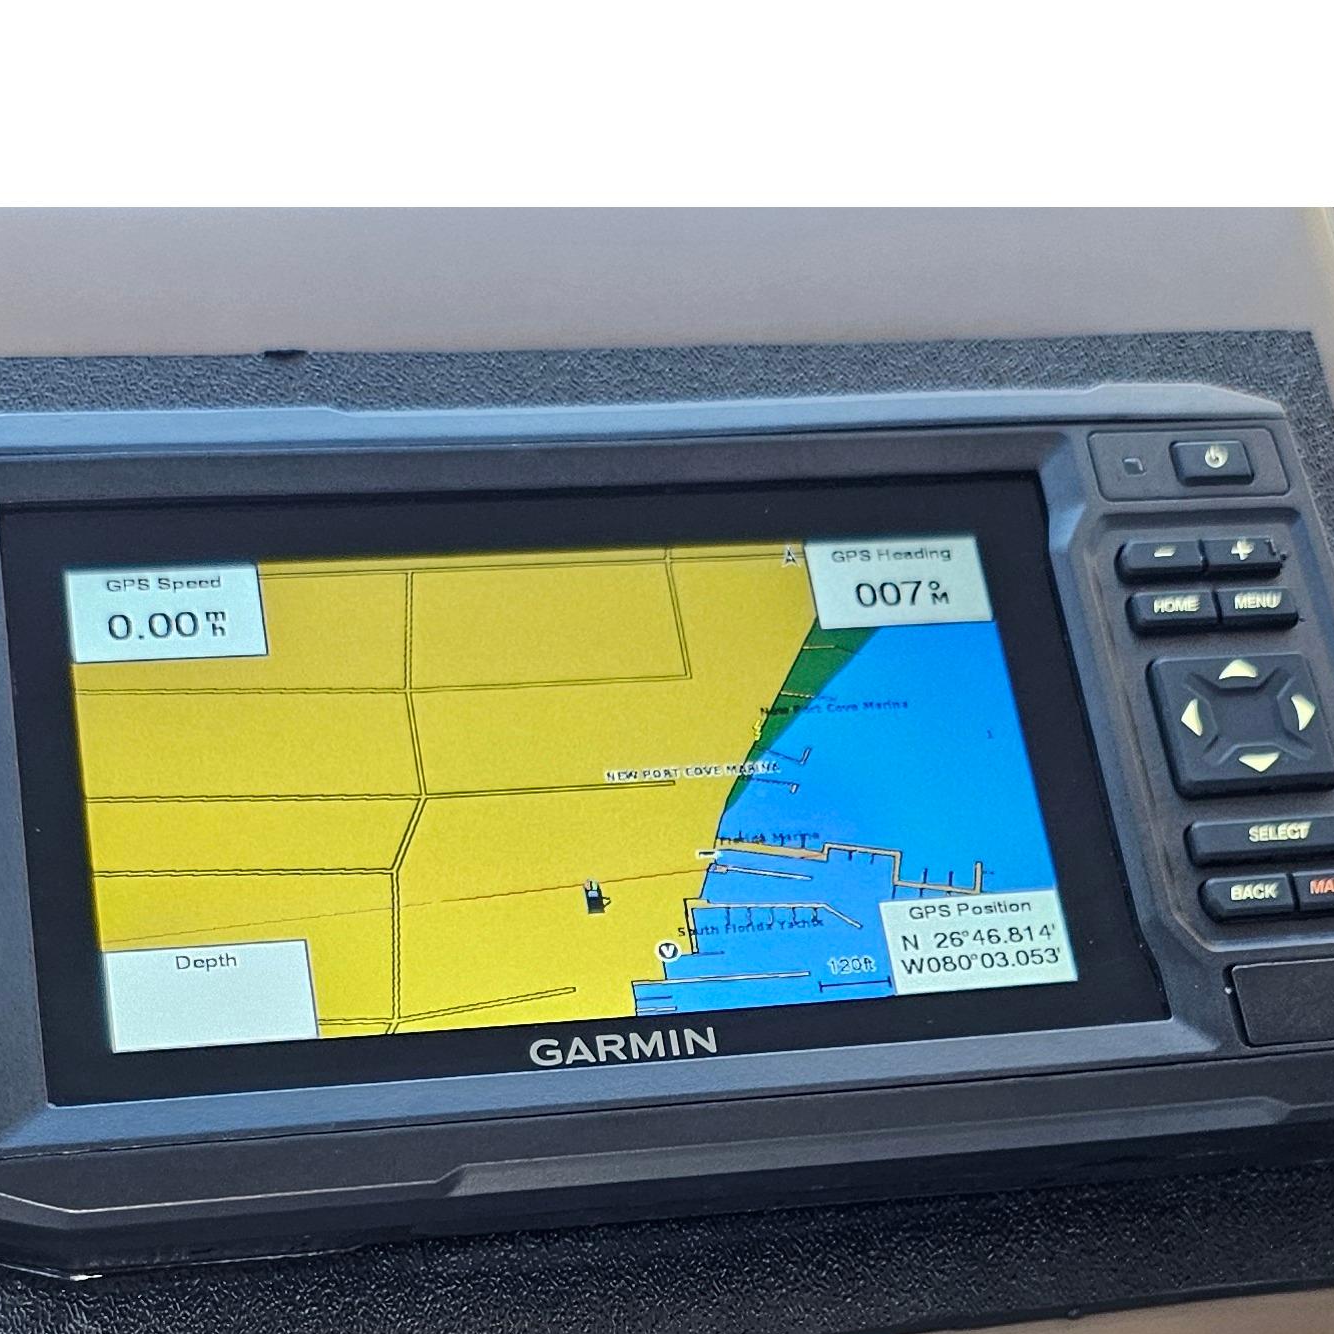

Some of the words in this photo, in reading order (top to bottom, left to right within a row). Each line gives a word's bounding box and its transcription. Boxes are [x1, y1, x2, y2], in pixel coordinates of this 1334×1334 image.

[831, 550, 871, 563] GPS
[877, 547, 951, 561] Heading
[106, 578, 150, 592] GPS
[157, 576, 221, 593] Speed
[1153, 595, 1200, 613] HOME
[1234, 591, 1282, 610] MENU
[107, 611, 199, 640] 0.00
[1248, 821, 1312, 842] SELECT
[1230, 881, 1278, 901] BACK
[909, 904, 951, 920] GPS
[957, 900, 1032, 917] Position
[902, 935, 919, 951] N
[175, 953, 237, 971] Depth
[529, 1026, 718, 1066] GARMIN
